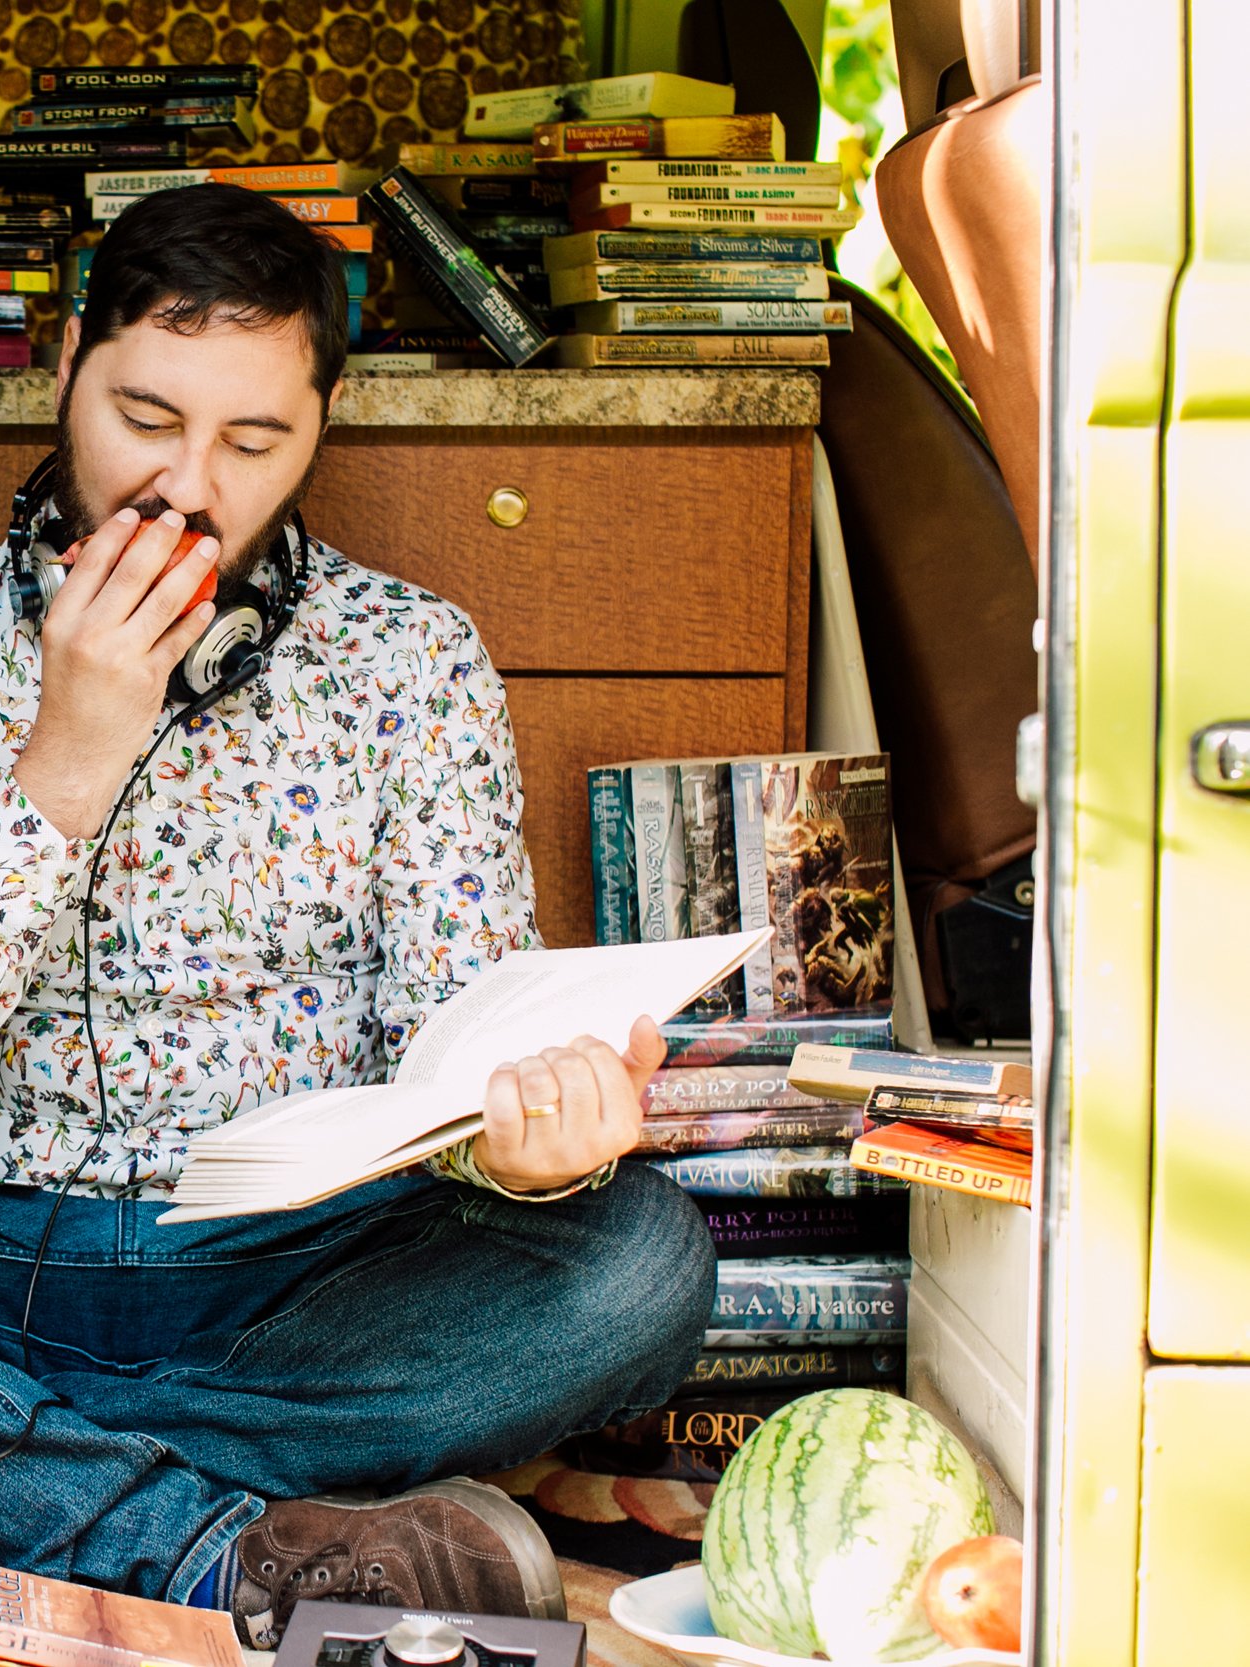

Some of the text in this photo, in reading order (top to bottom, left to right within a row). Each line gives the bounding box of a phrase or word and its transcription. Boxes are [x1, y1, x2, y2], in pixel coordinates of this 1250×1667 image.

[66, 73, 167, 86] FOOL MOON
[44, 108, 95, 121] STORM
[99, 105, 148, 118] FRONT
[51, 141, 97, 153] PERIL
[250, 171, 296, 185] FOURTH
[297, 170, 328, 183] BEAR
[658, 163, 719, 177] FOUNDATION
[746, 165, 772, 175] Isaac
[773, 165, 807, 176] Asimov
[97, 175, 147, 191] JASPER
[668, 186, 795, 200] FOUNDATION Isaac Asimov
[669, 207, 824, 223] SECOND FOUNDATION Isaac Asimov
[393, 195, 457, 264] JIM BUTCHER
[699, 237, 750, 253] Streams
[760, 238, 795, 254] Silver
[482, 297, 517, 335] GUILTY
[487, 286, 528, 333] PROVEN
[746, 301, 810, 319] SOJOURN
[733, 336, 774, 354] EXILE
[647, 1079, 740, 1098] HARRY
[649, 1096, 789, 1111] AND THE CHAMBER OF
[639, 1122, 810, 1143] HARRY POTTER
[972, 1174, 1004, 1192] UP
[707, 1207, 856, 1228] RRY POTTER
[718, 1293, 895, 1316] R.A. Salvatore
[665, 1410, 765, 1448] LORD
